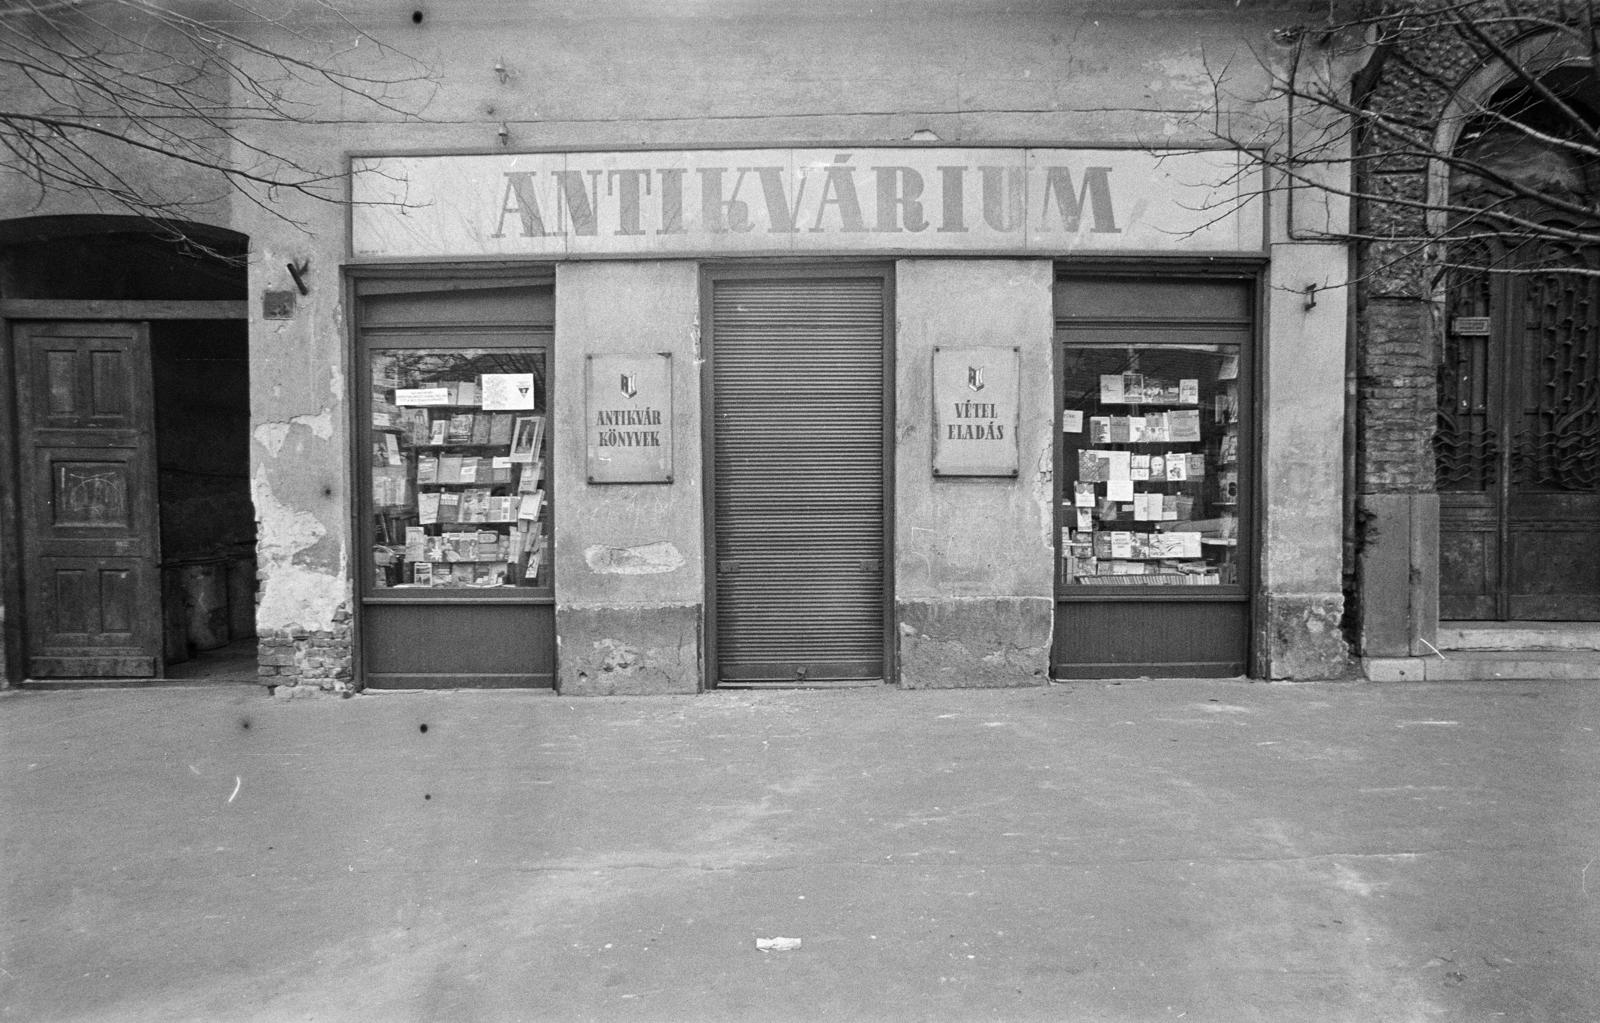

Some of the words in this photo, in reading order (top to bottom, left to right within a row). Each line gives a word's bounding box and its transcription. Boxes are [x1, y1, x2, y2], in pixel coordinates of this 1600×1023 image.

[491, 154, 1122, 238] ANTIKVÁRIUM
[597, 407, 661, 425] ANTIKVÁR
[955, 400, 997, 419] VÉTEL
[599, 429, 660, 447] KÖNYVEK
[948, 421, 1003, 440] ELADÁS
